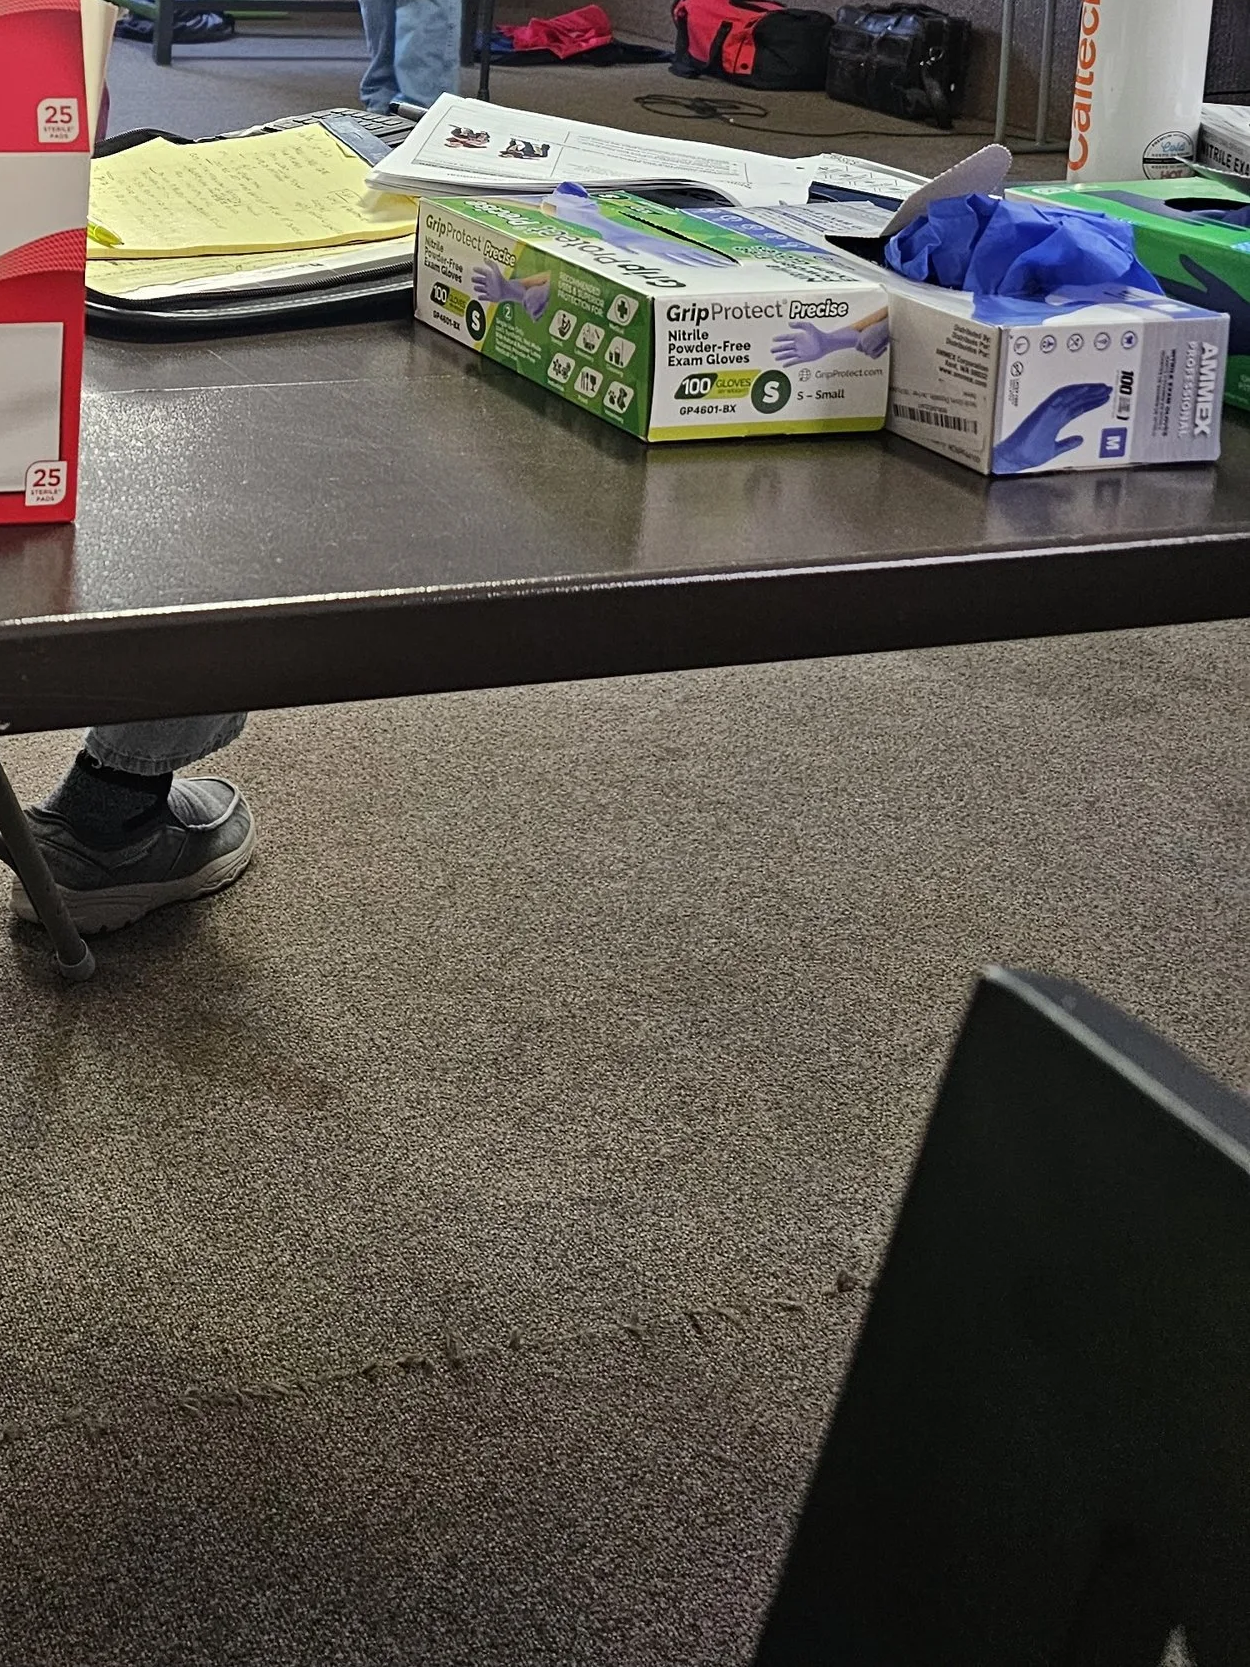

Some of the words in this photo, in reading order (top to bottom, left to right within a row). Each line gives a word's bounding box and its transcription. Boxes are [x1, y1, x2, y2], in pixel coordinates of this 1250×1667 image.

[45, 105, 72, 124] 25
[483, 240, 517, 267] Precise
[433, 285, 448, 303] 100
[789, 299, 849, 319] Precise
[471, 310, 481, 332] S
[668, 330, 709, 341] Nitrile
[668, 341, 751, 354] Powder-Free
[668, 356, 703, 367] Exam
[706, 354, 750, 365] Gloves
[716, 378, 751, 388] GLOVES
[815, 368, 883, 380] GripProtect.com
[1119, 370, 1135, 396] 100
[682, 378, 711, 395] 100
[762, 380, 780, 403] S
[797, 391, 803, 400] S
[815, 389, 844, 400] Small
[1177, 341, 1199, 439] PROFESSIONAL
[1194, 341, 1219, 437] AMMEX
[679, 404, 736, 415] GP4601-BX
[1106, 435, 1120, 451] M
[33, 468, 61, 487] 25
